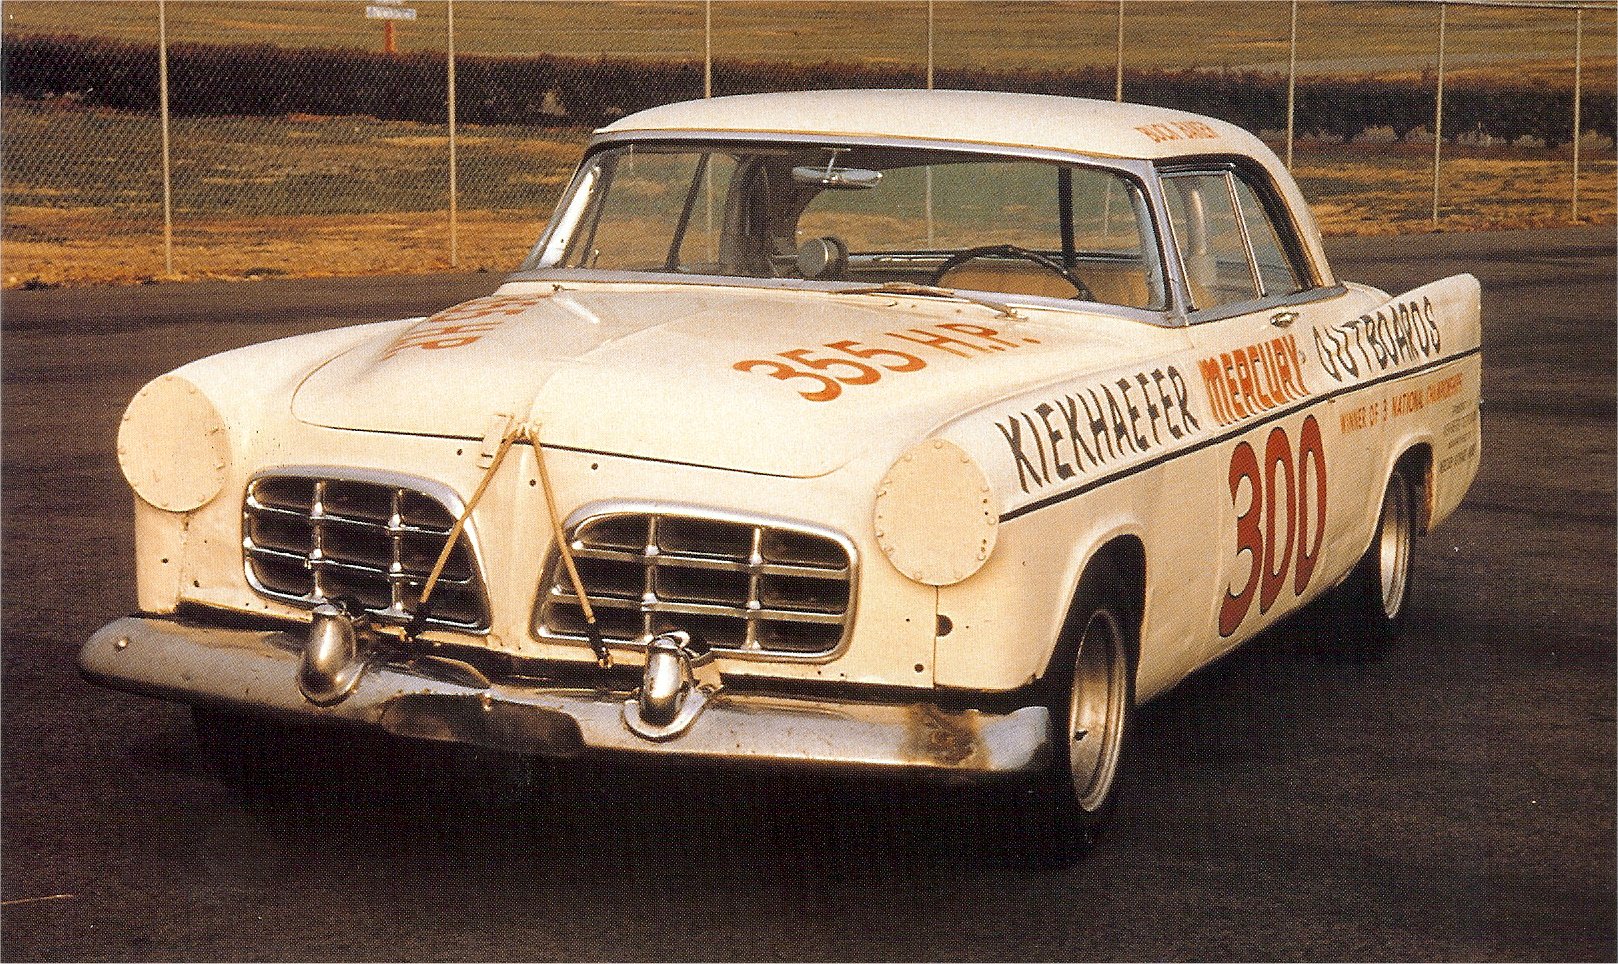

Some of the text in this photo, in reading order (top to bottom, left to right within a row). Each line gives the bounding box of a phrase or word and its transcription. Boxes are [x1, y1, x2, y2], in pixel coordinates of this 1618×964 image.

[732, 322, 1041, 402] 355 H.P.
[994, 296, 1441, 494] KIEKHAEFER MERCURY OUTBOARDS
[1369, 402, 1379, 426] OF
[1218, 414, 1327, 638] 300
